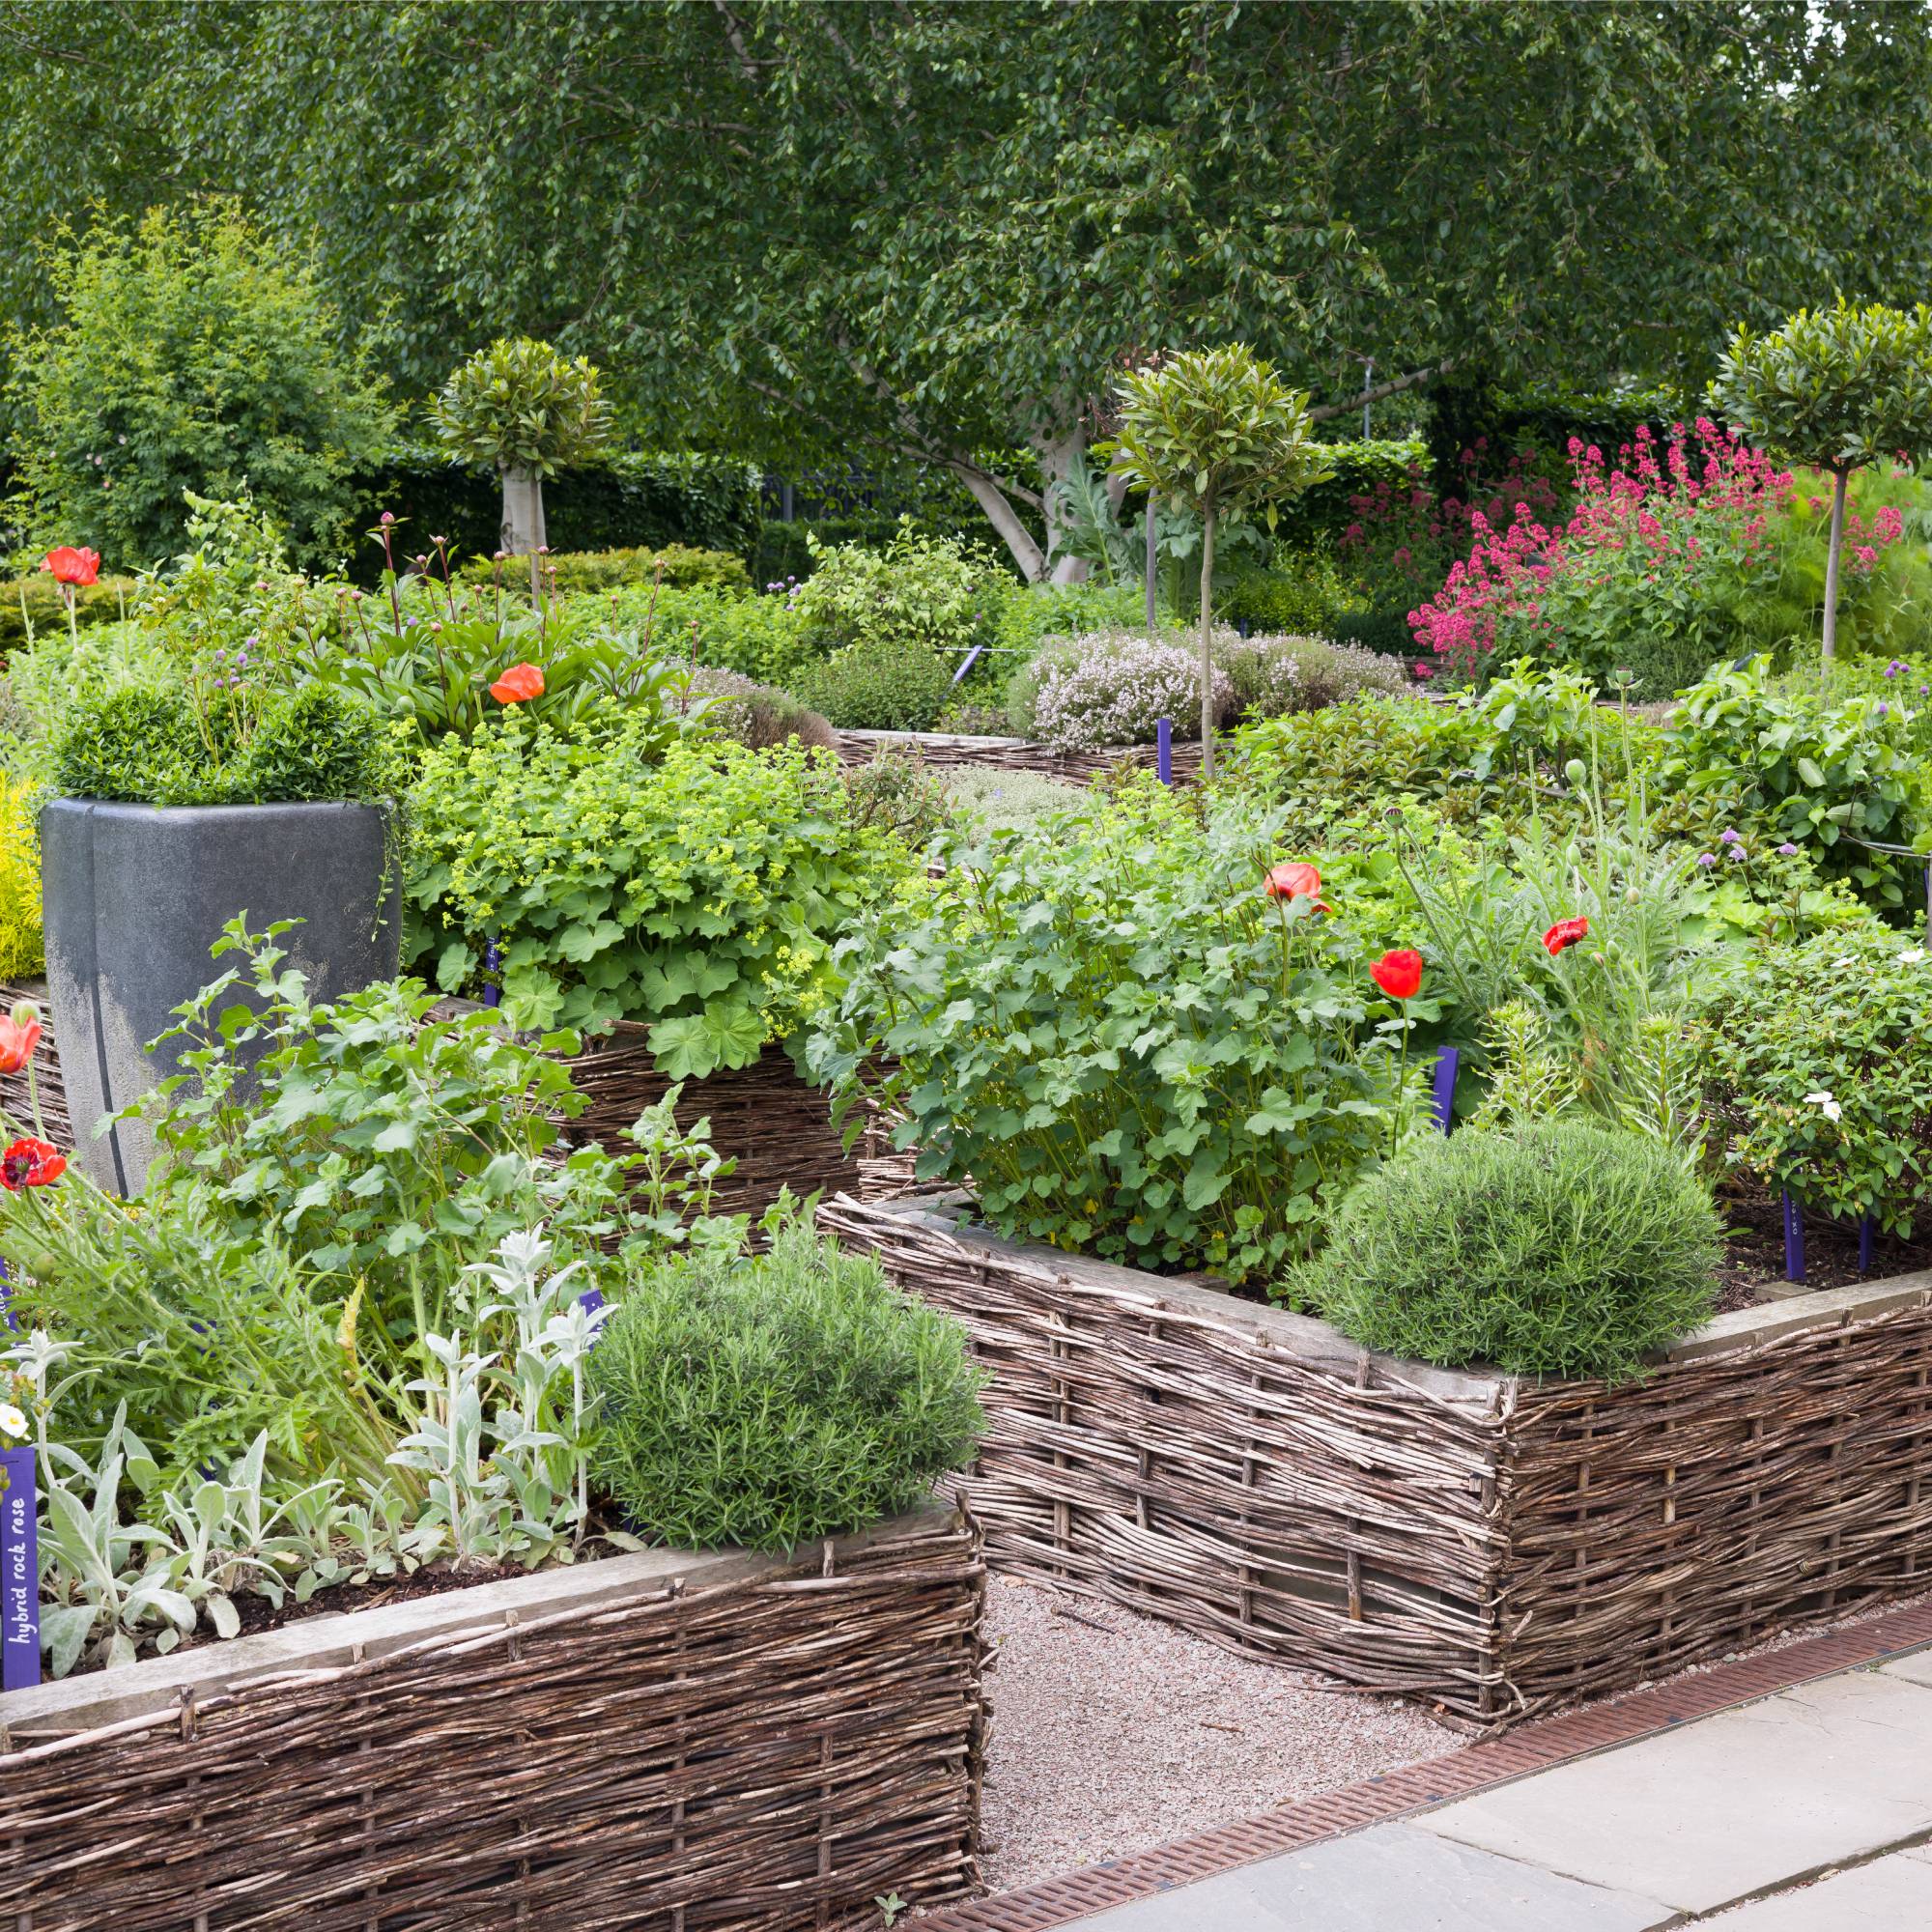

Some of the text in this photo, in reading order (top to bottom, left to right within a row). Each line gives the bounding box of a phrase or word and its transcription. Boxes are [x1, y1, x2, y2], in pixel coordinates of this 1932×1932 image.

[8, 1497, 38, 1644] hybrid rock rose
